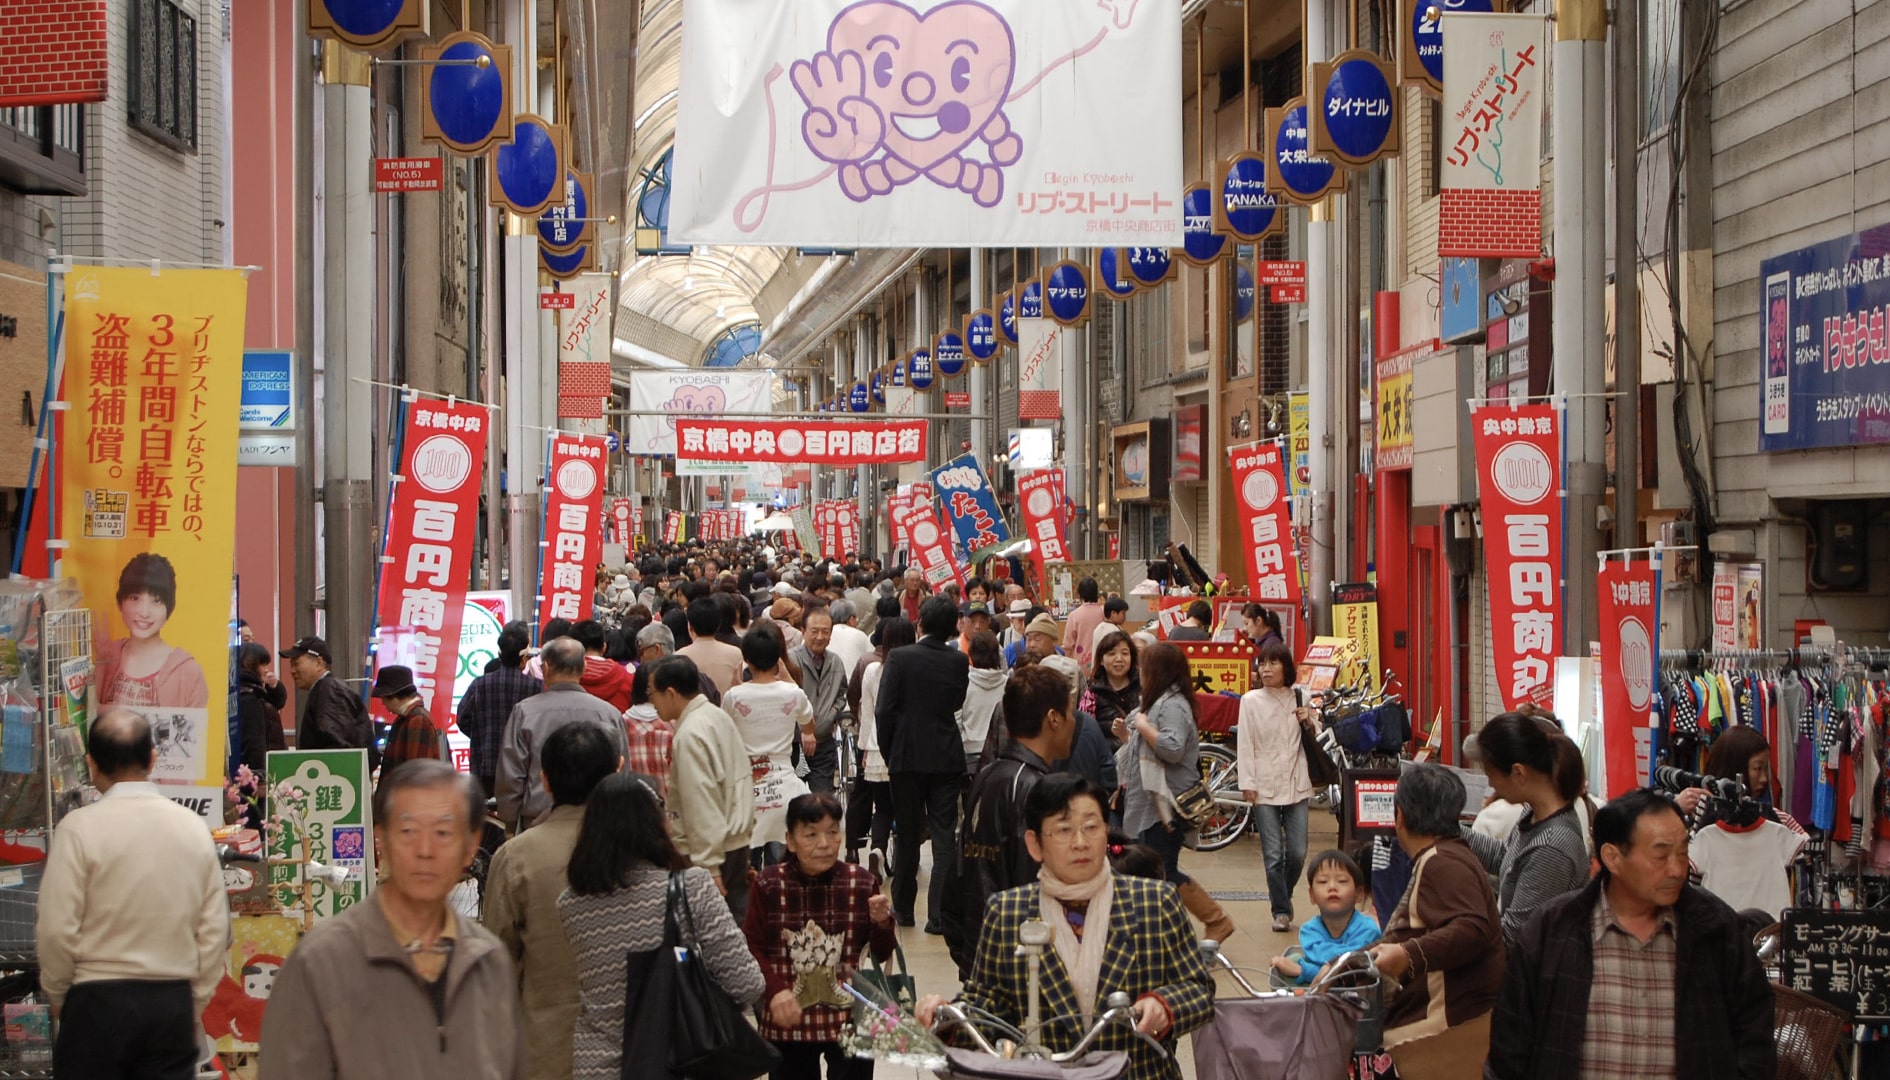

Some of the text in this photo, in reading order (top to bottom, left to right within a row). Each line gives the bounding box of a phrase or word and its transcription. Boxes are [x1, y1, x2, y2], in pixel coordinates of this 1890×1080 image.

[1328, 97, 1389, 117] ダイナビル
[1446, 45, 1536, 167] リブ・ストリート
[1017, 190, 1173, 214] リブ・ストリート
[1225, 193, 1276, 206] TANAKA
[1086, 219, 1177, 233] 京橋中央商店街
[1047, 286, 1087, 300] マツモリ
[562, 289, 607, 351] リブ・ストリート
[669, 375, 730, 385] KYOBASHI
[86, 312, 131, 480] 盗難補償。
[1769, 383, 1785, 400] うきうき
[415, 410, 481, 433] 京橋中央
[1768, 403, 1786, 421] CARD
[133, 313, 180, 539] 3年間自転車
[182, 313, 215, 542] ブリヂストンならではの、
[557, 442, 601, 458] 京橋中央
[682, 427, 776, 455] 京橋中央
[804, 428, 921, 456] 百円商店街
[422, 449, 461, 479] 100
[1807, 942, 1824, 953] AM
